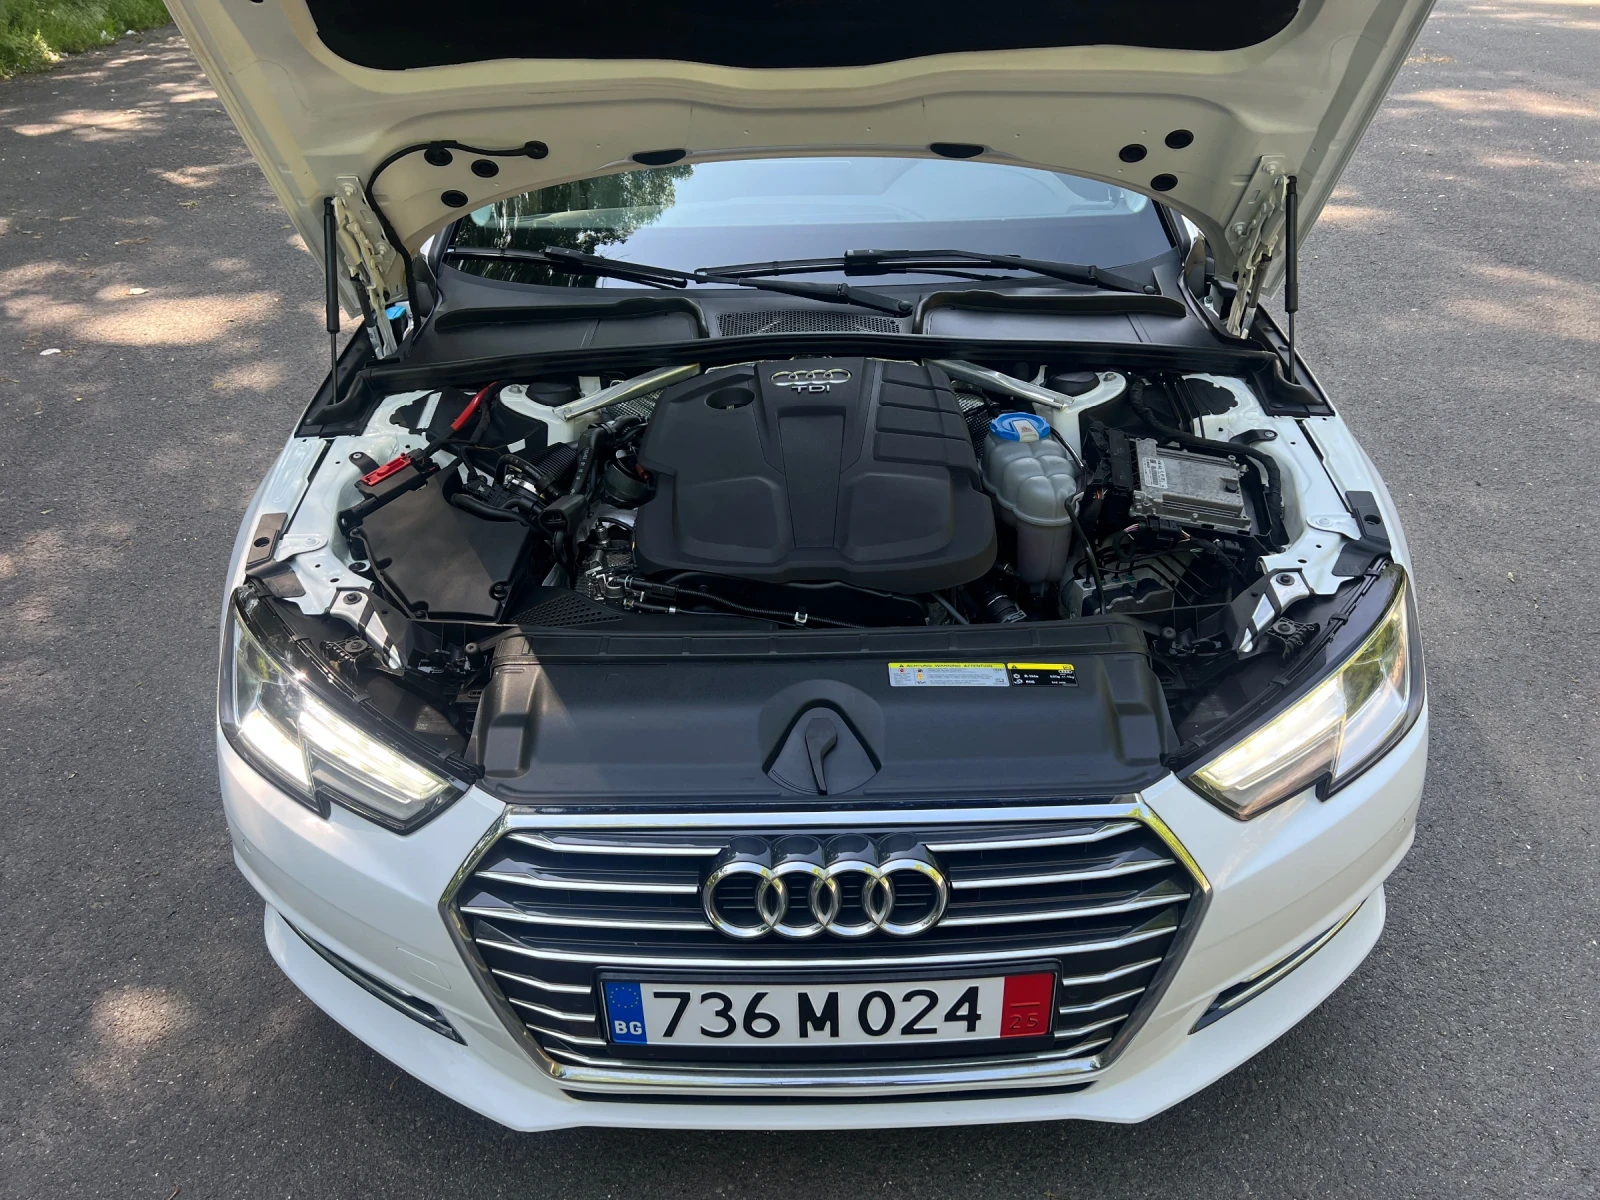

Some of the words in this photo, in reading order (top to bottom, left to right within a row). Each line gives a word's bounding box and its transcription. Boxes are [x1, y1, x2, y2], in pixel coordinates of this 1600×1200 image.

[791, 384, 830, 393] TDI
[653, 991, 781, 1039] 736
[797, 991, 840, 1039] M
[857, 986, 982, 1037] 024
[614, 1020, 643, 1035] BG
[1010, 1013, 1039, 1030] 25
